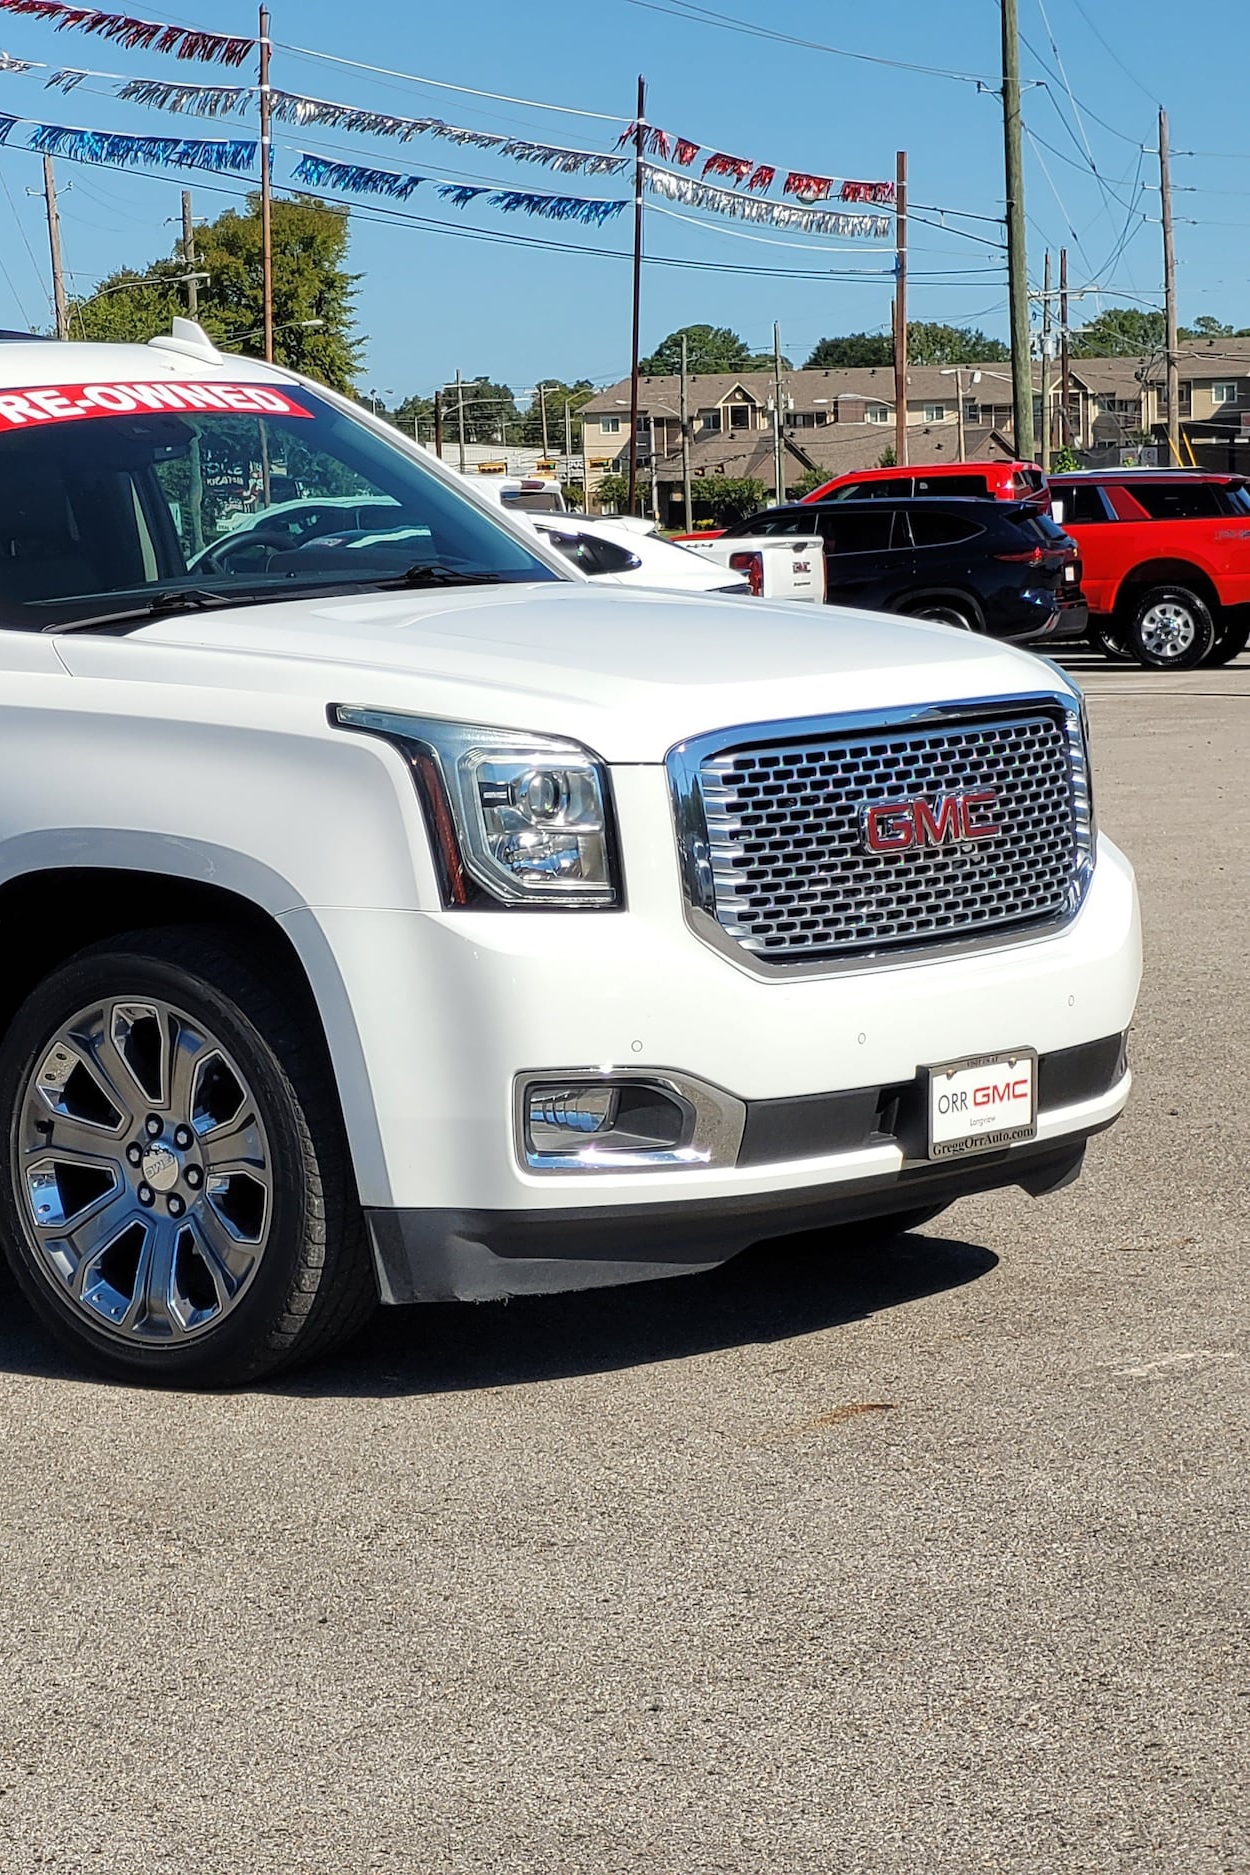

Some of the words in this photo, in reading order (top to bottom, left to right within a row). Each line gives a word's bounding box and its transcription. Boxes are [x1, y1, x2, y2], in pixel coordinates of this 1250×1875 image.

[863, 790, 1001, 853] GMC
[938, 1091, 968, 1114] ORR
[973, 1079, 1028, 1107] GMC
[970, 1115, 996, 1127] Longview
[933, 1128, 1033, 1156] GreggOrrAuto.com
